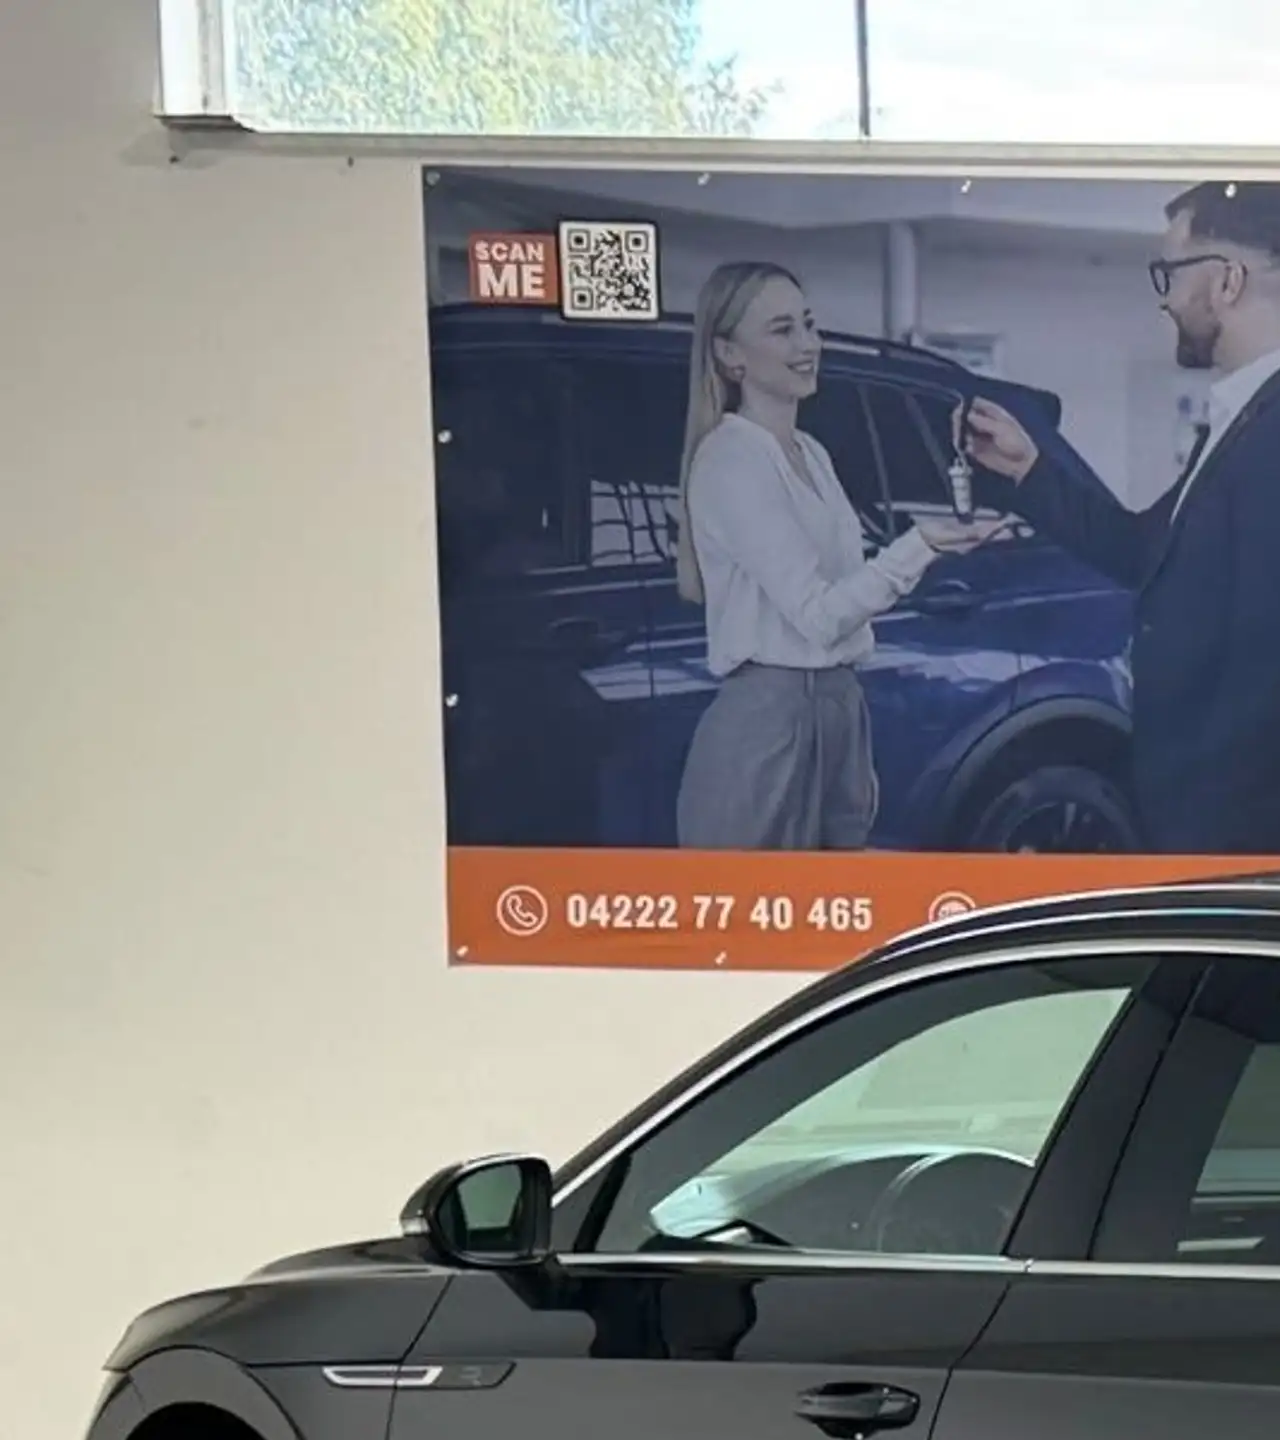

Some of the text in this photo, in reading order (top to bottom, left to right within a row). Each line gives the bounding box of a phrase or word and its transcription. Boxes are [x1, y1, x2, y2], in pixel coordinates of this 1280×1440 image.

[474, 240, 545, 263] SCAN
[477, 263, 546, 299] ME
[566, 893, 873, 932] 04222 77 40 465
